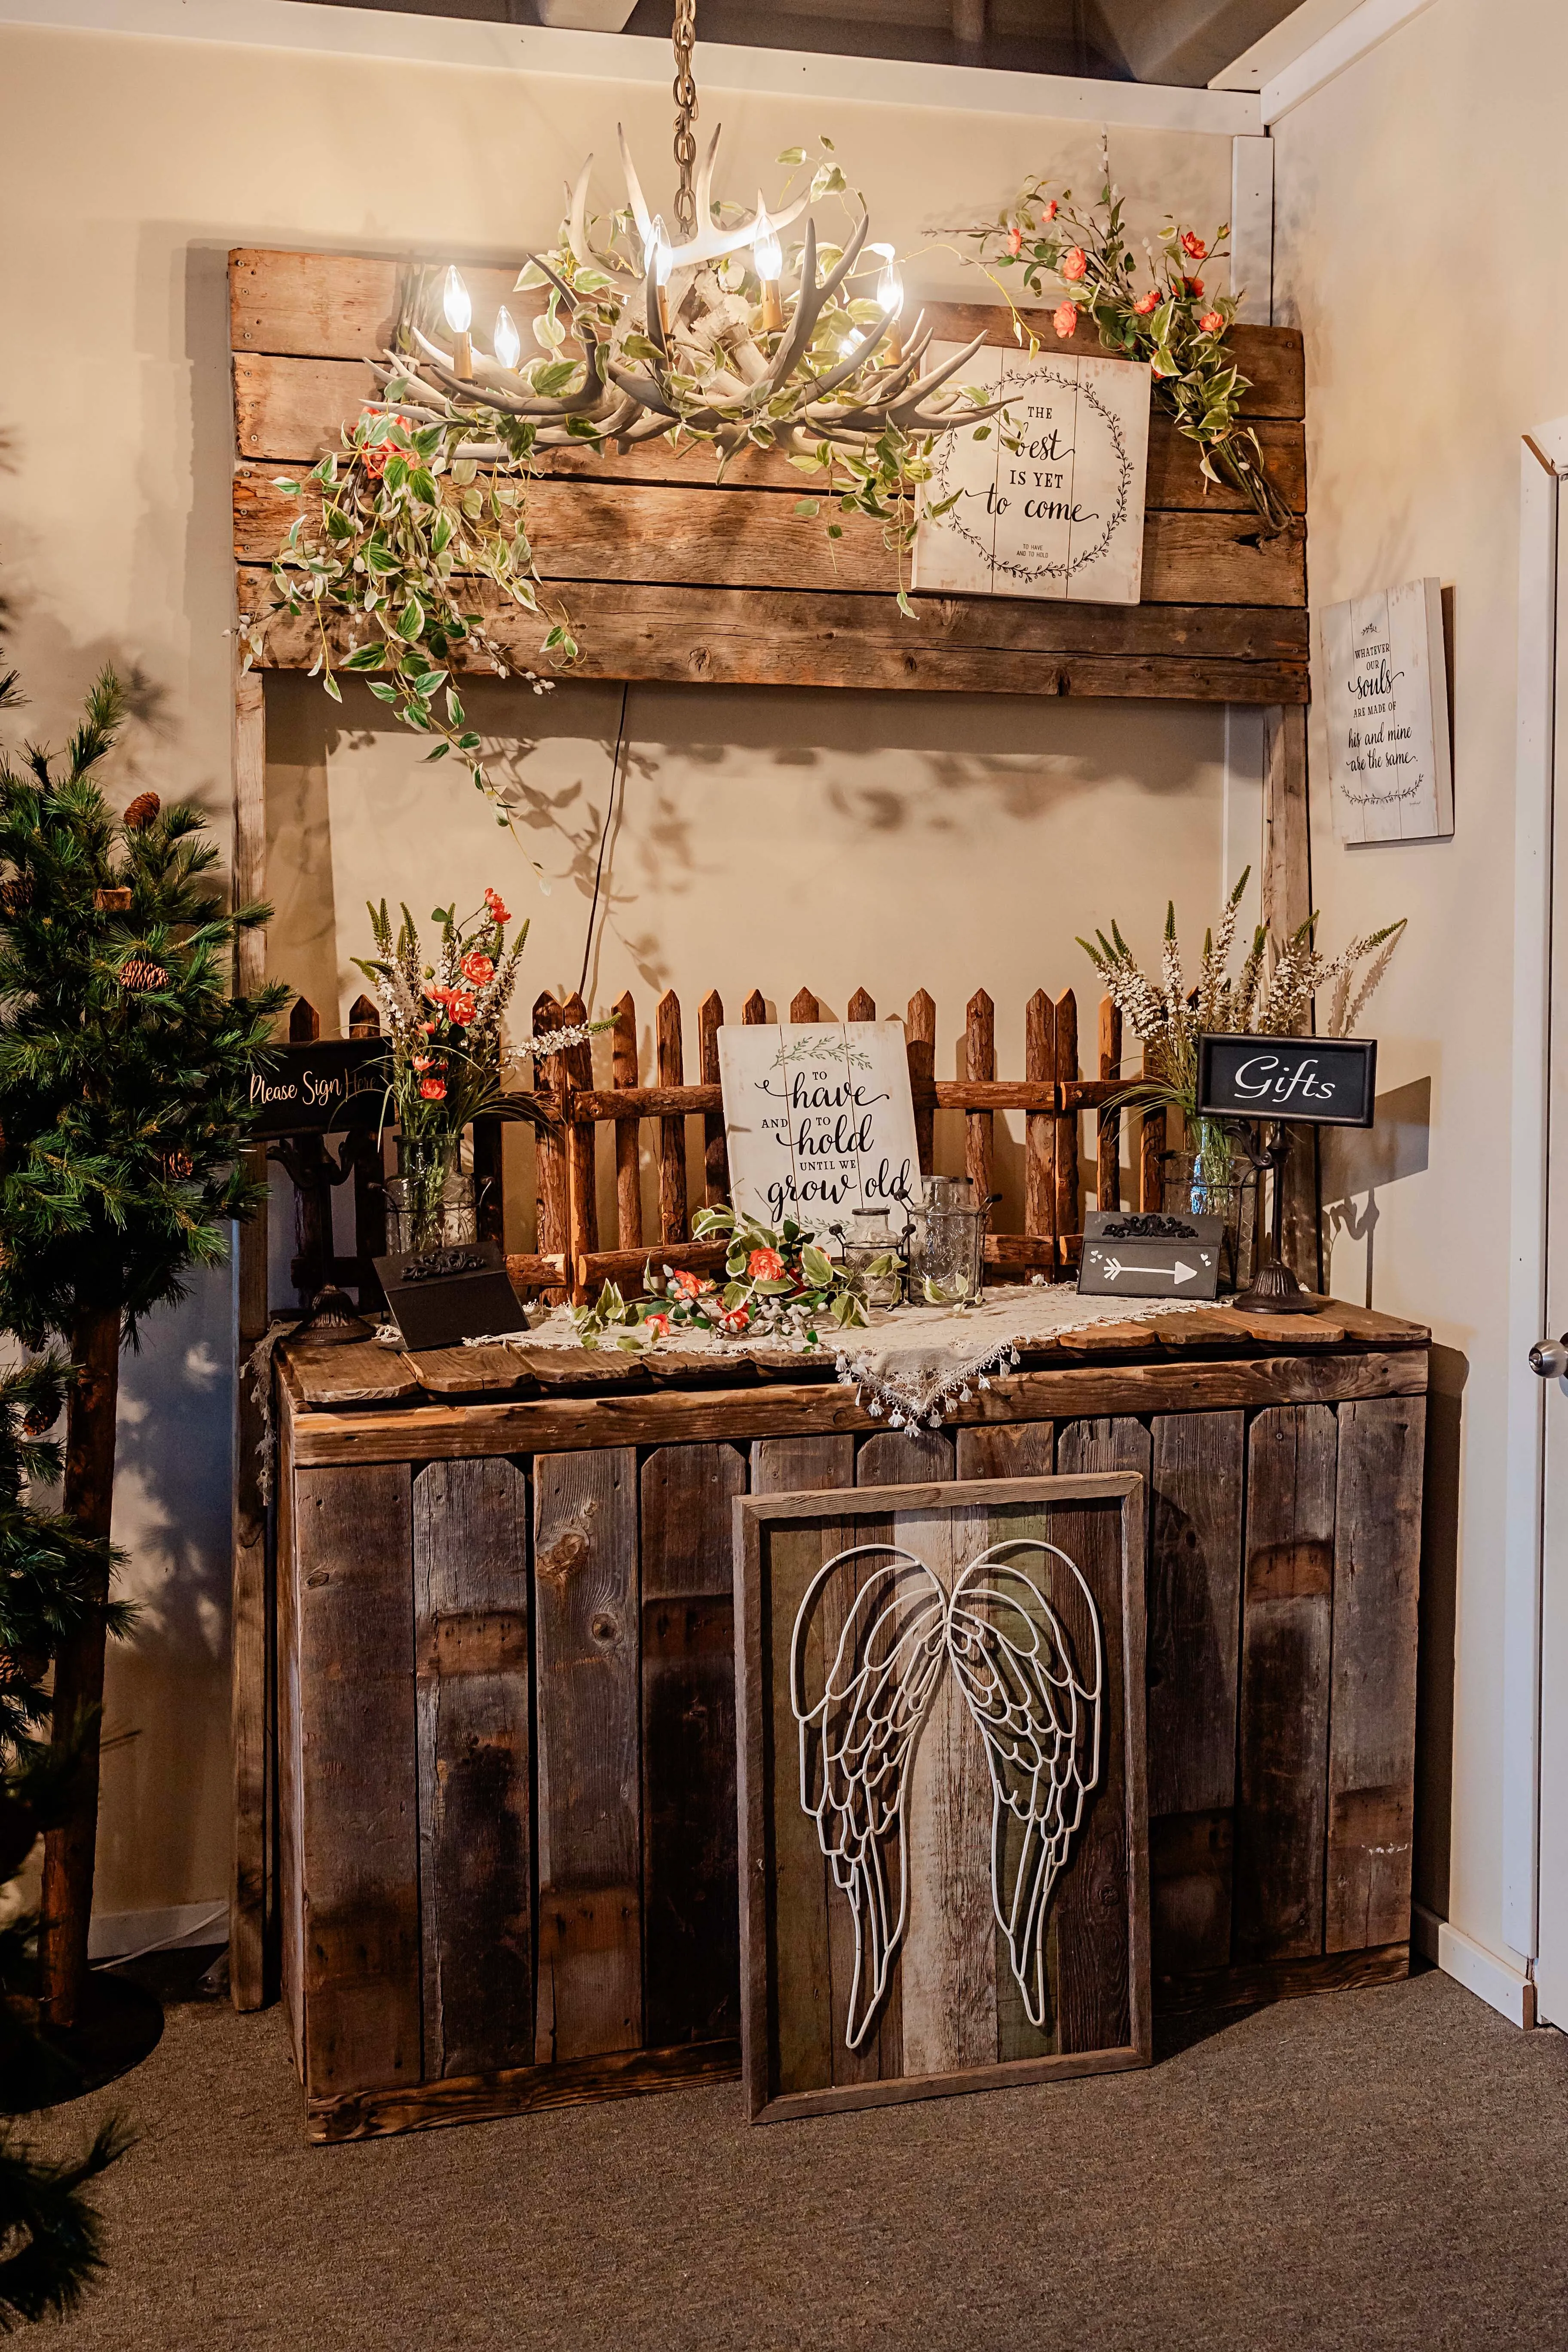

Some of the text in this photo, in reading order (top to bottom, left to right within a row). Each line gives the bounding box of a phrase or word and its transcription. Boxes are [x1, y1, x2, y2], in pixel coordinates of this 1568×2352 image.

[1028, 406, 1052, 419] THE
[1000, 422, 1075, 461] best
[1009, 470, 1063, 488] IS YET
[965, 483, 1099, 522] to come
[1354, 643, 1390, 659] WHATEVER
[1366, 660, 1379, 671] OUR
[1348, 658, 1404, 700] souls
[1354, 701, 1396, 718] ARE MADE OF
[1348, 722, 1412, 748] his and mine
[1346, 748, 1418, 772] are the same.
[250, 1068, 377, 1109] Please Sign Here
[812, 1071, 828, 1081] TO
[1234, 1056, 1336, 1102] Gifts
[754, 1071, 890, 1109] have
[761, 1117, 831, 1129] AND TO
[776, 1113, 874, 1156] hold
[799, 1160, 856, 1171] UNTIL WE
[768, 1158, 913, 1223] grow old
